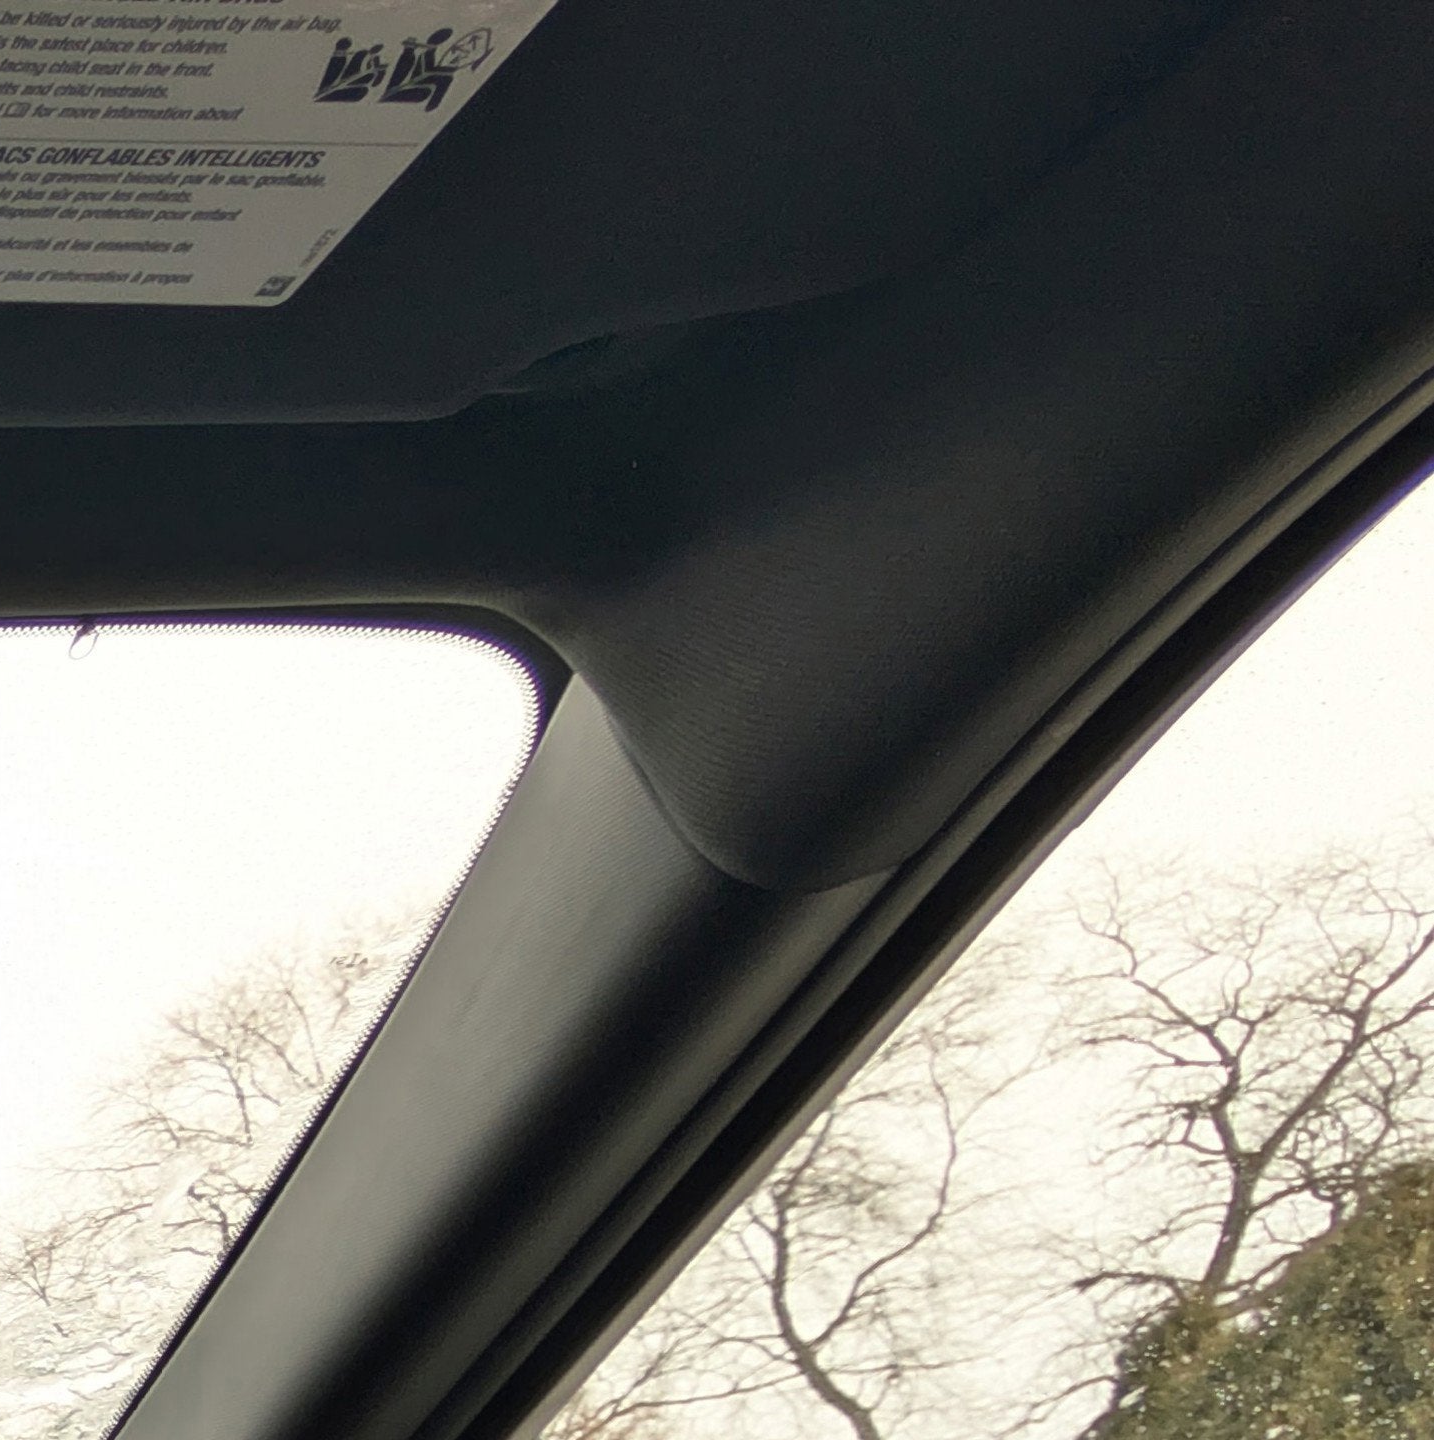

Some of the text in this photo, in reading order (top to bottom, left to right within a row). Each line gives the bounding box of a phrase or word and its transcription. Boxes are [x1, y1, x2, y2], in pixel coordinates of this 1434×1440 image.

[23, 10, 71, 27] killed
[70, 15, 91, 28] or
[91, 14, 166, 31] seriously
[167, 14, 227, 32] injured
[226, 15, 250, 32] by
[251, 16, 280, 31] the
[280, 15, 305, 31] air
[306, 15, 344, 33] bag.
[10, 34, 38, 50] the
[38, 36, 90, 51] safest
[88, 37, 133, 54] place
[135, 38, 159, 53] for
[161, 38, 229, 54] children.
[47, 59, 89, 75] child
[87, 61, 125, 75] seat
[124, 61, 142, 76] in
[143, 62, 170, 76] the
[172, 61, 216, 76] front.
[20, 82, 53, 96] and
[53, 83, 94, 97] child
[94, 84, 170, 98] restraints.
[37, 146, 172, 166] GONFLABLES
[176, 149, 324, 168] INTELLIGENTS
